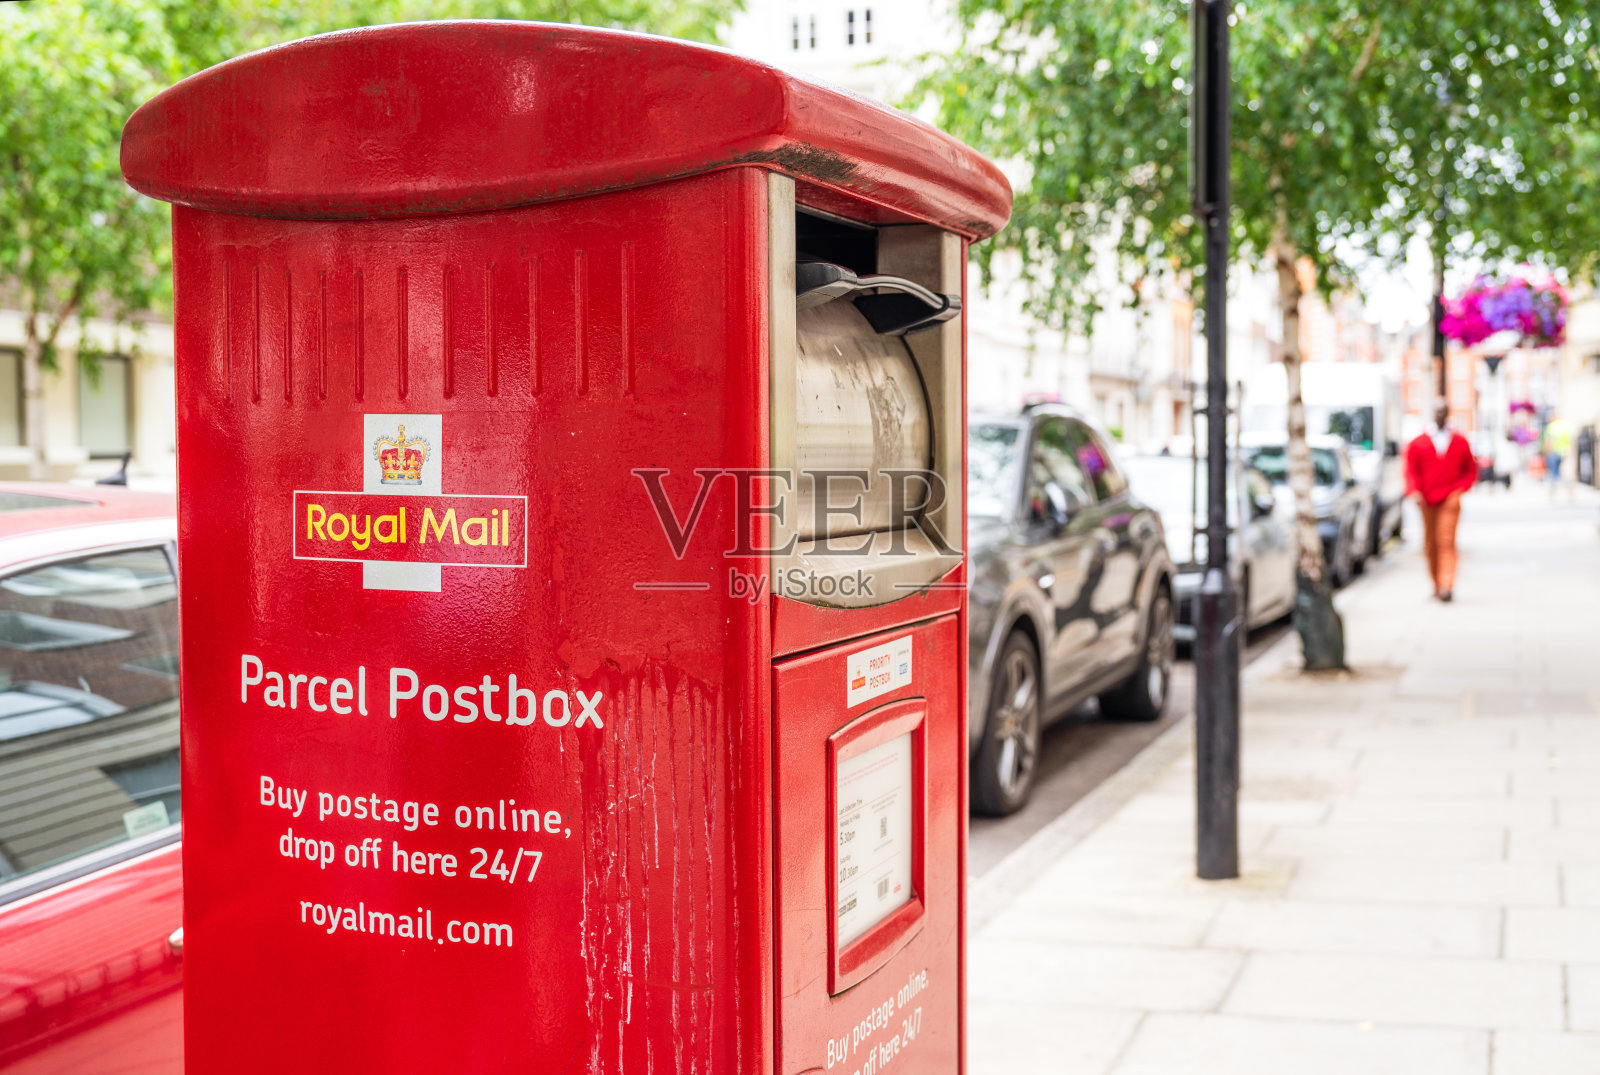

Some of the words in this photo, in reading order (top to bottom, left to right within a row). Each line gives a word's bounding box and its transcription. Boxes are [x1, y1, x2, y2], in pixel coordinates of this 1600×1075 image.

[307, 503, 407, 551] Royal
[419, 507, 509, 547] Mail
[241, 653, 368, 716] Parcel
[389, 667, 604, 729] Postbox
[869, 653, 891, 673] PRIORITY
[869, 671, 891, 690] POSTBOX
[259, 775, 307, 818] Buy
[318, 792, 440, 831] postage
[454, 798, 573, 839] online,
[279, 827, 335, 870] drop
[344, 837, 382, 870] off
[392, 841, 458, 877] here
[469, 846, 543, 884] 24/7
[300, 900, 514, 947] royalmail.com
[827, 1033, 849, 1070] Buy
[853, 996, 895, 1055] postage
[879, 1034, 900, 1069] here
[902, 1006, 922, 1048] 24/7
